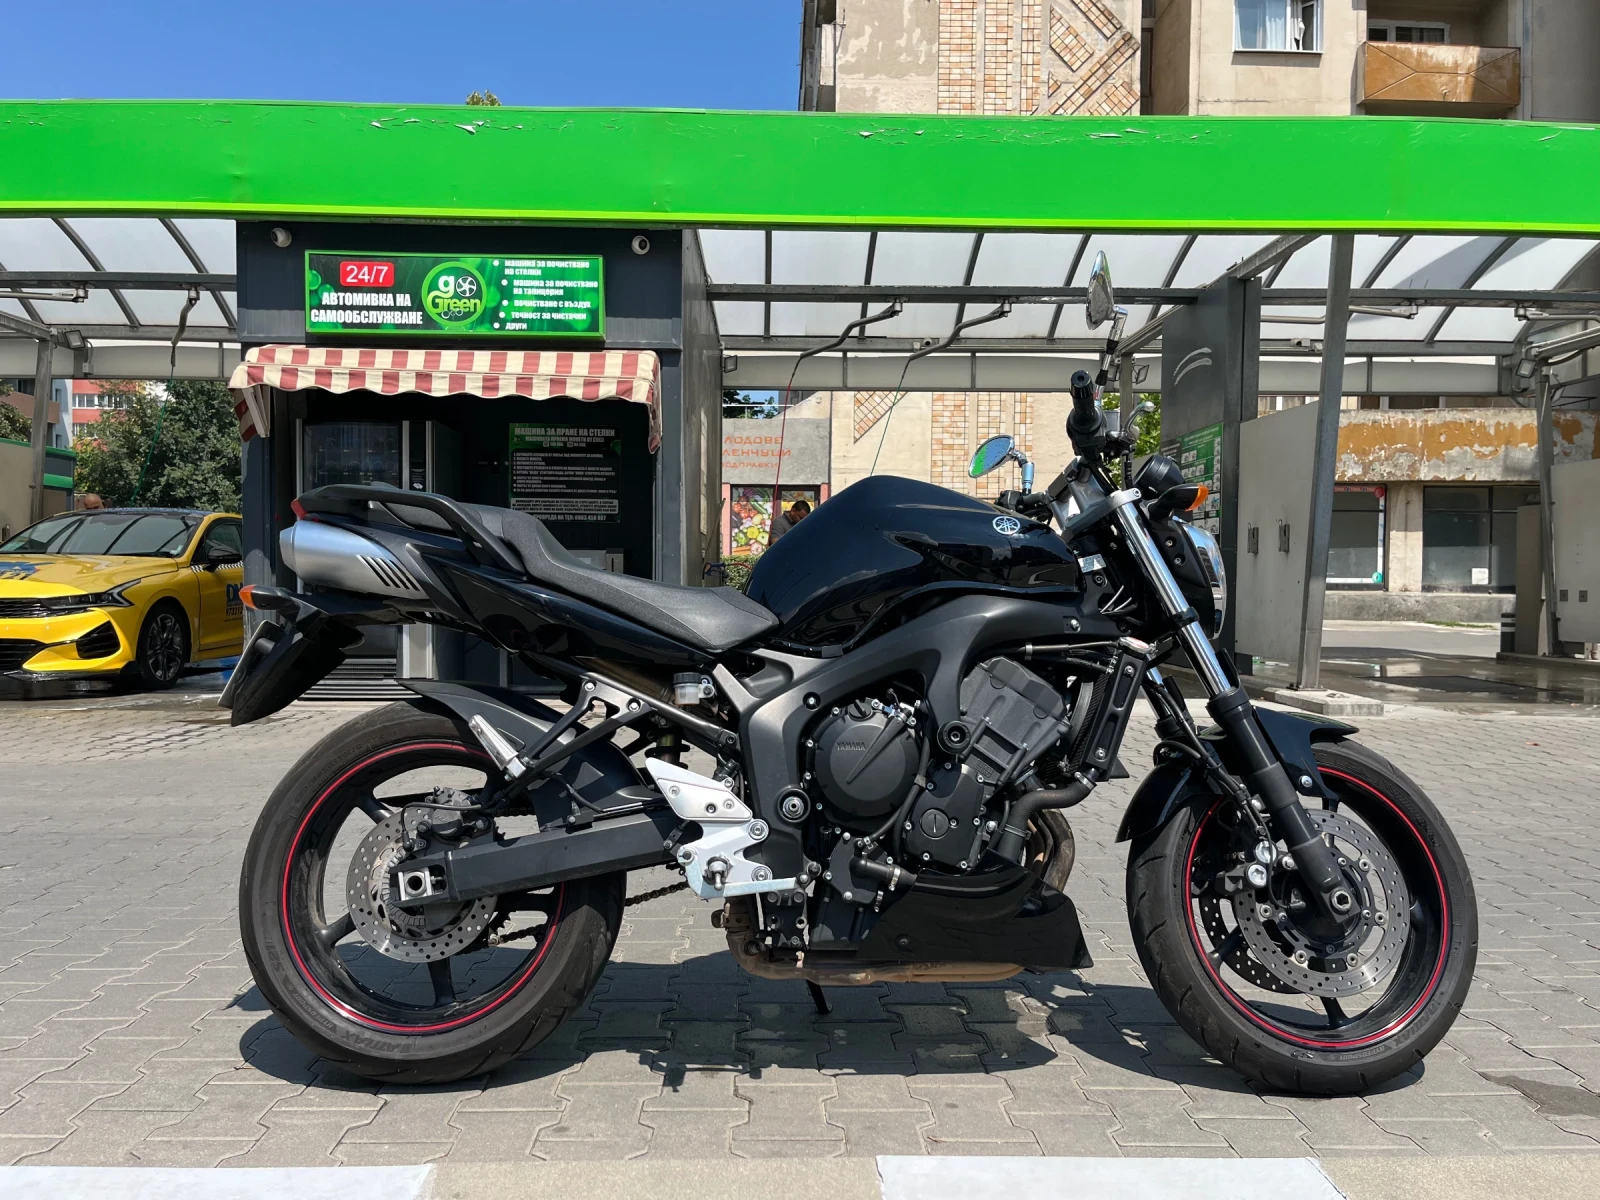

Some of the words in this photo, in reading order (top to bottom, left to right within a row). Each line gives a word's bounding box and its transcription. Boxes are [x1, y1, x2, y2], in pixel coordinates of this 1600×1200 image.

[346, 265, 389, 283] 24/7
[513, 279, 545, 287] машина
[513, 287, 522, 295] на
[322, 291, 395, 306] АВТОМИВКА
[396, 293, 412, 307] НА
[427, 290, 481, 313] Green
[310, 309, 423, 325] САМООБСЛУЖВАНЕ
[505, 322, 528, 330] други
[514, 427, 546, 436] МАШИНА
[546, 428, 556, 436] ЗА
[556, 428, 578, 436] ПРАНЕ
[579, 428, 588, 436] НА
[588, 428, 615, 437] СТЕЛКИ
[724, 435, 783, 445] ЛОДОВЕ
[722, 448, 791, 457] ЛЕНЧУЦИ
[836, 741, 866, 751] YAMAHA
